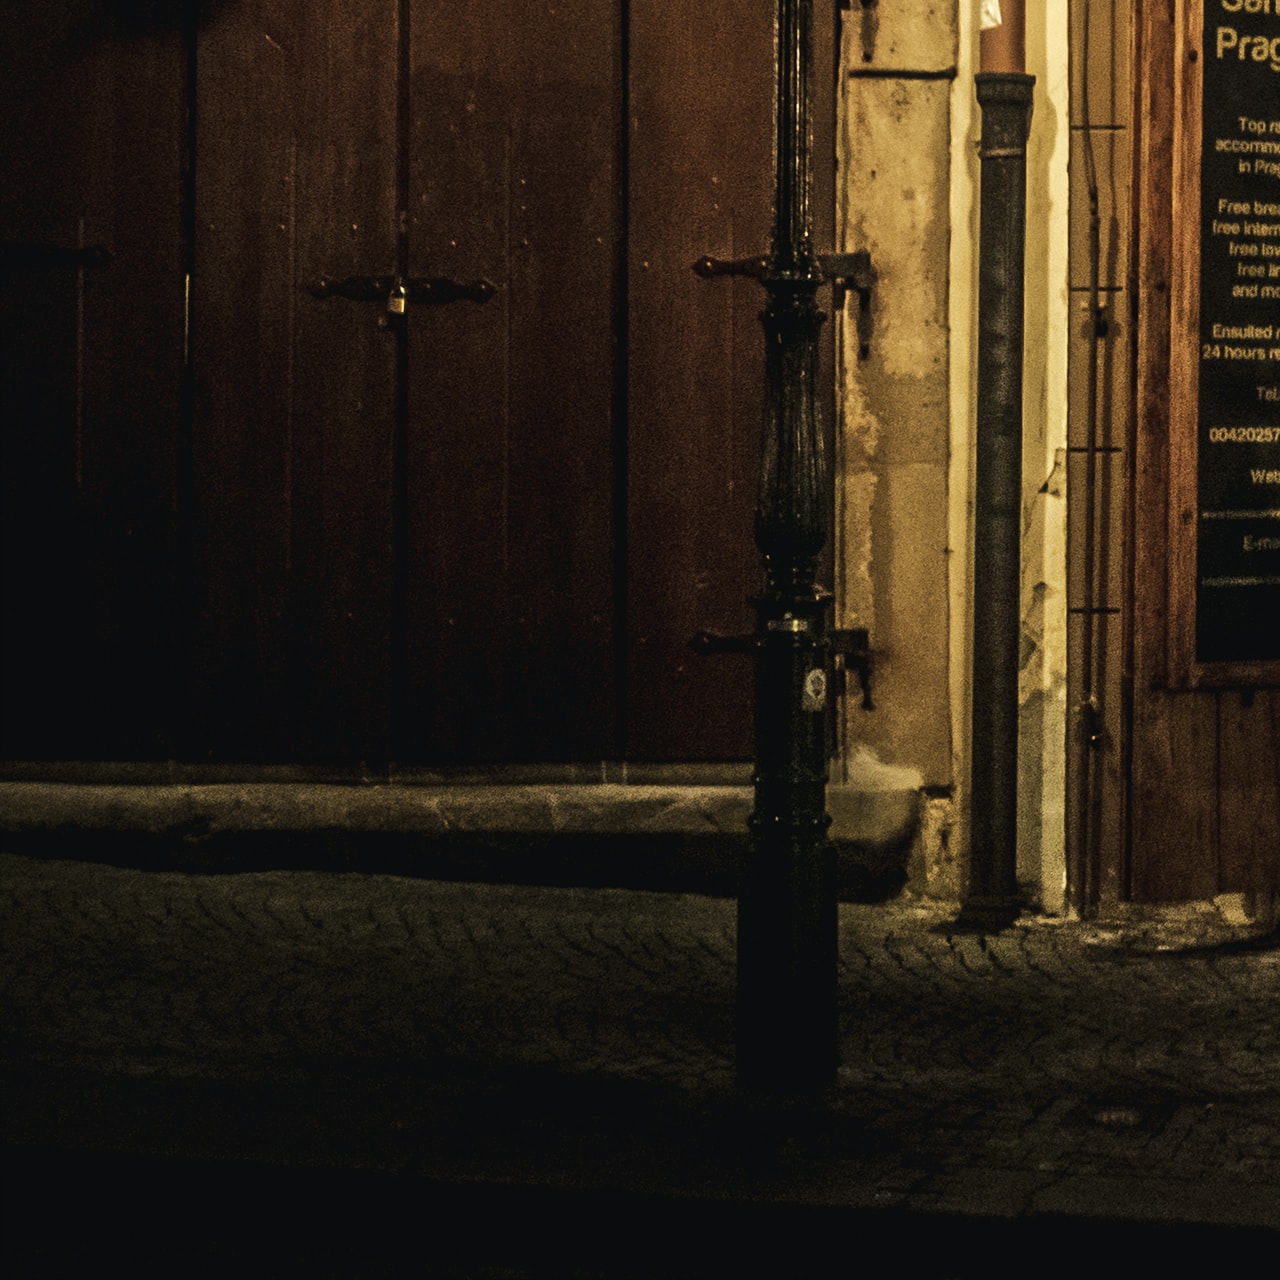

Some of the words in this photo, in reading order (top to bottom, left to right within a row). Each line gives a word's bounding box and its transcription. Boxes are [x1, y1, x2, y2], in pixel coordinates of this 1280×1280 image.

[1238, 115, 1266, 135] Top
[1238, 159, 1251, 173] in
[1218, 198, 1250, 215] Free
[1212, 219, 1240, 235] free
[1229, 241, 1258, 256] free
[1237, 261, 1266, 278] free
[1232, 284, 1258, 298] and
[1212, 323, 1273, 340] Ensuited
[1202, 344, 1221, 360] 24
[1224, 345, 1266, 360] hours
